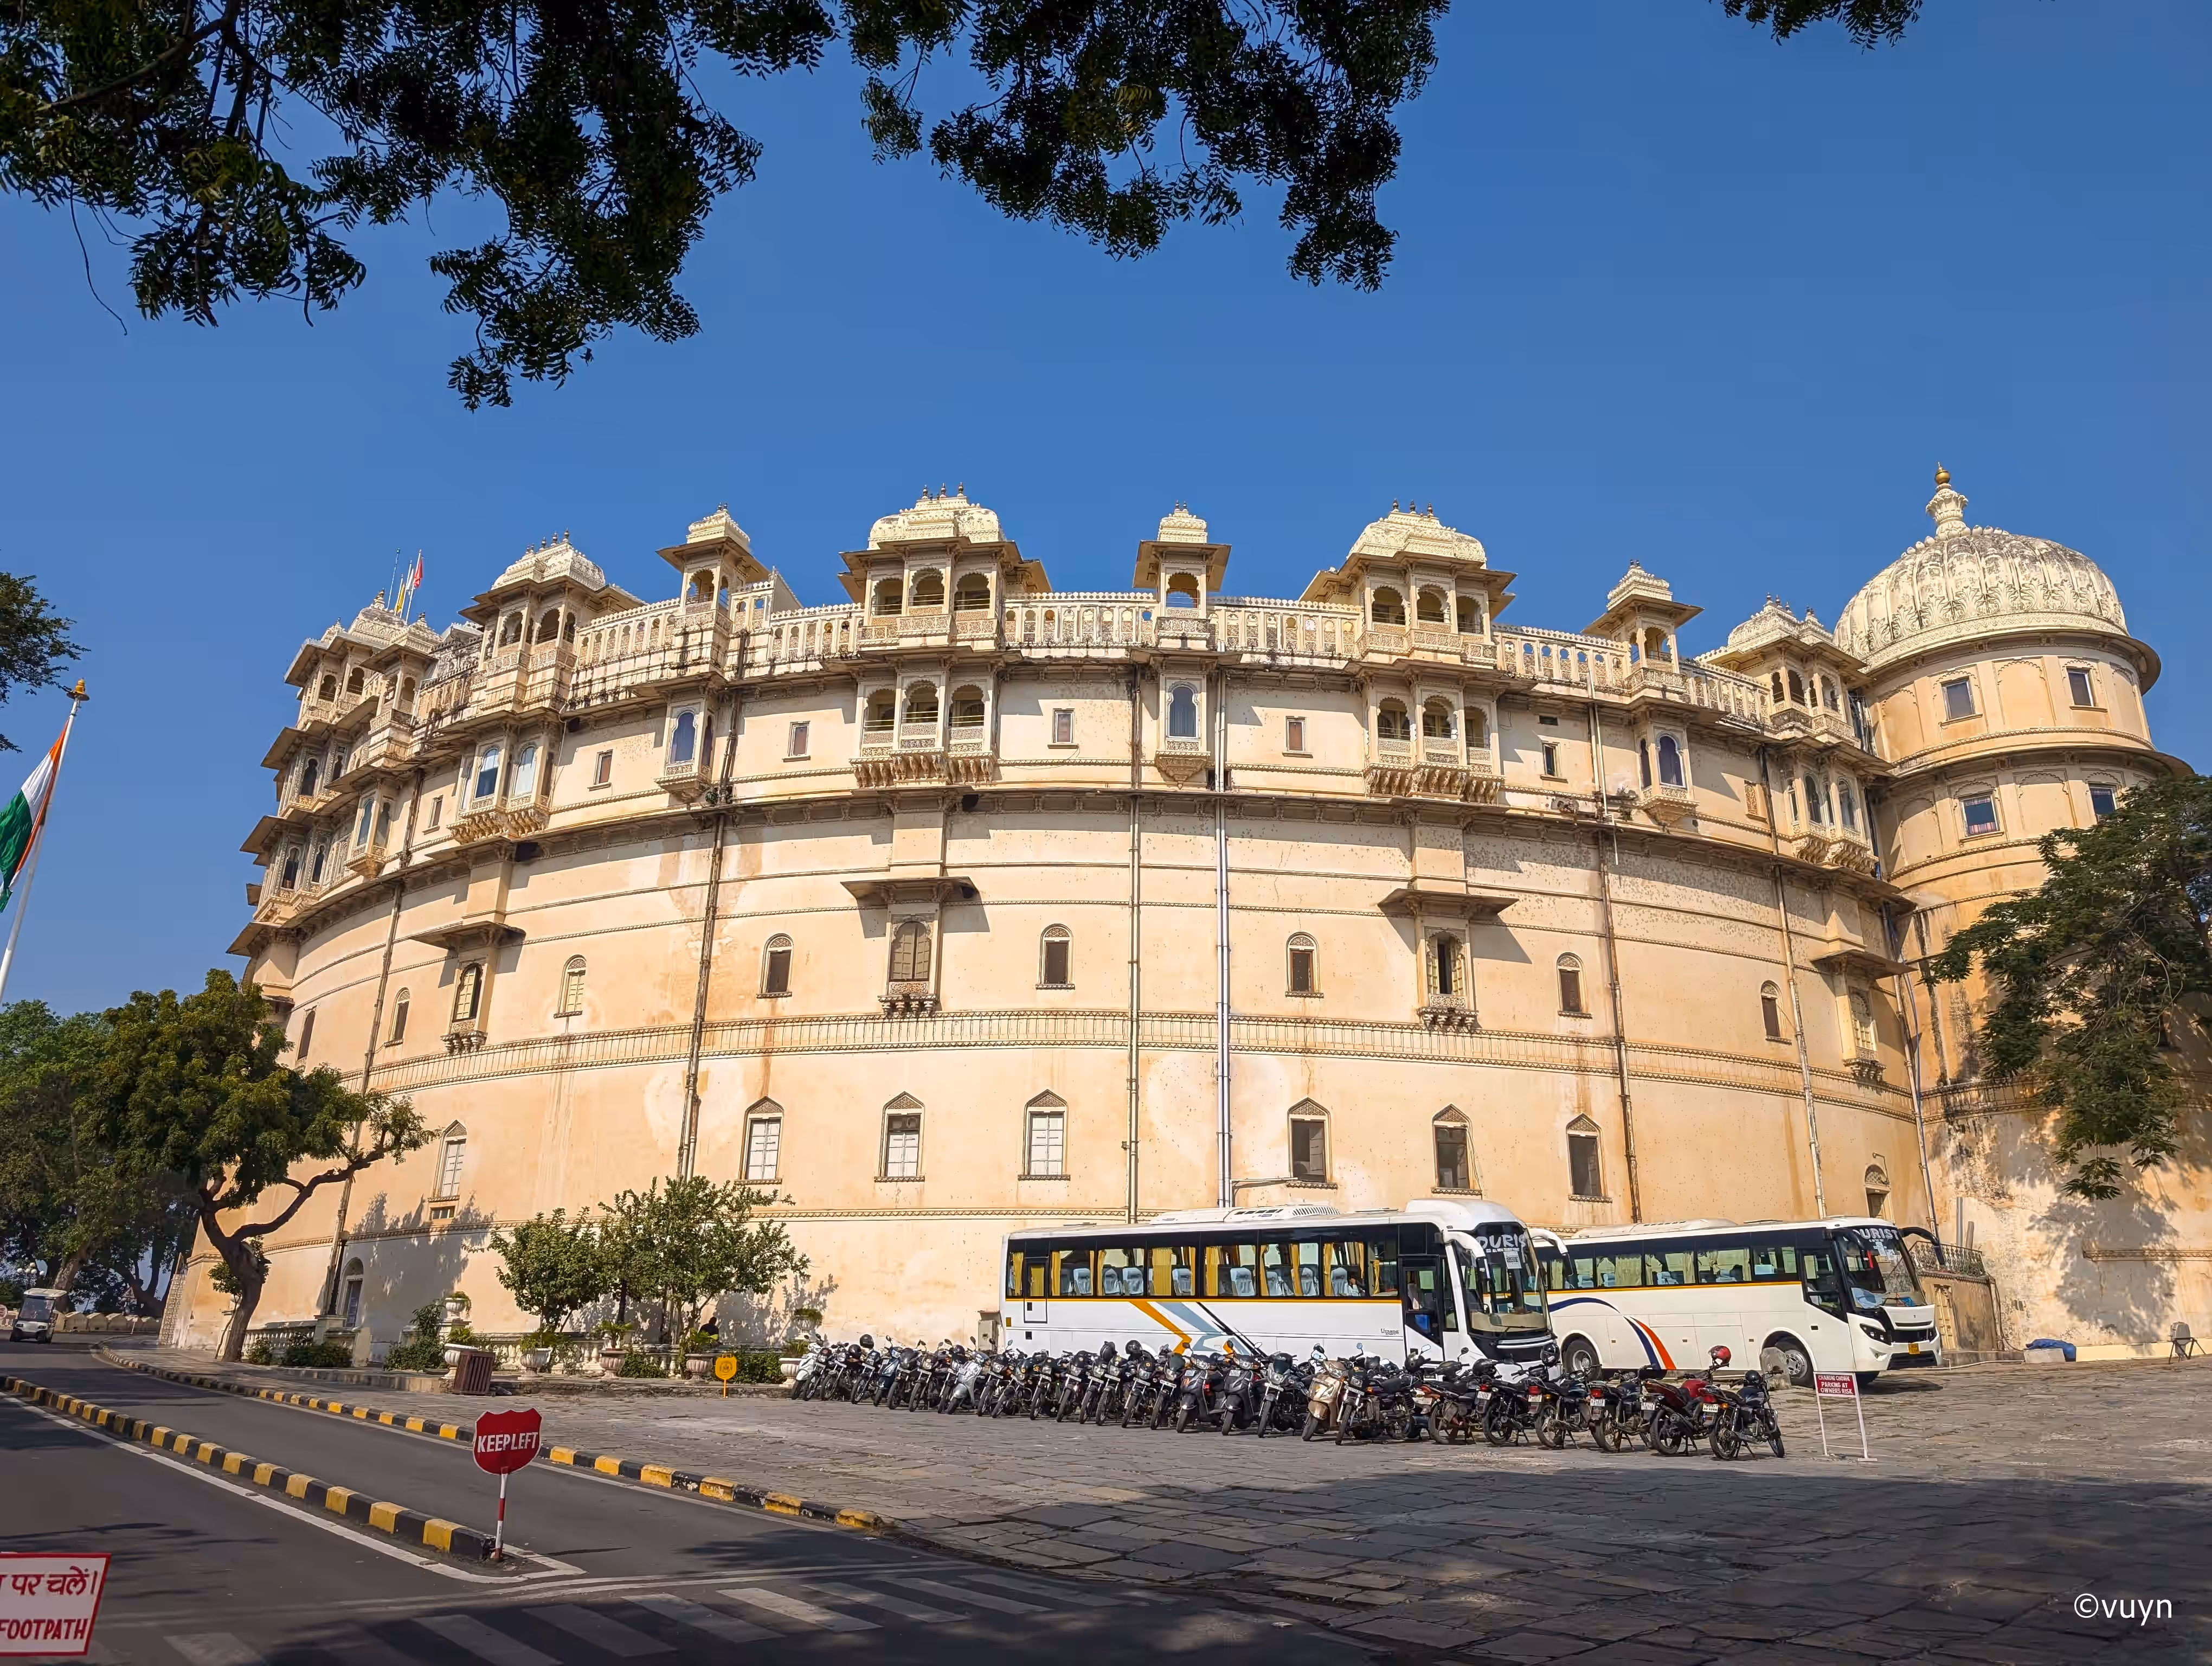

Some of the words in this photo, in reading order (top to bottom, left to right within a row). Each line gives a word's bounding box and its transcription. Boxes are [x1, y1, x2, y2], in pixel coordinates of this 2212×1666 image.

[1853, 1228, 1899, 1240] URIST
[477, 1434, 511, 1453] KEEP
[511, 1432, 538, 1450] LEFT
[11, 1574, 44, 1595] पर
[0, 1618, 88, 1640] FOOTPATH
